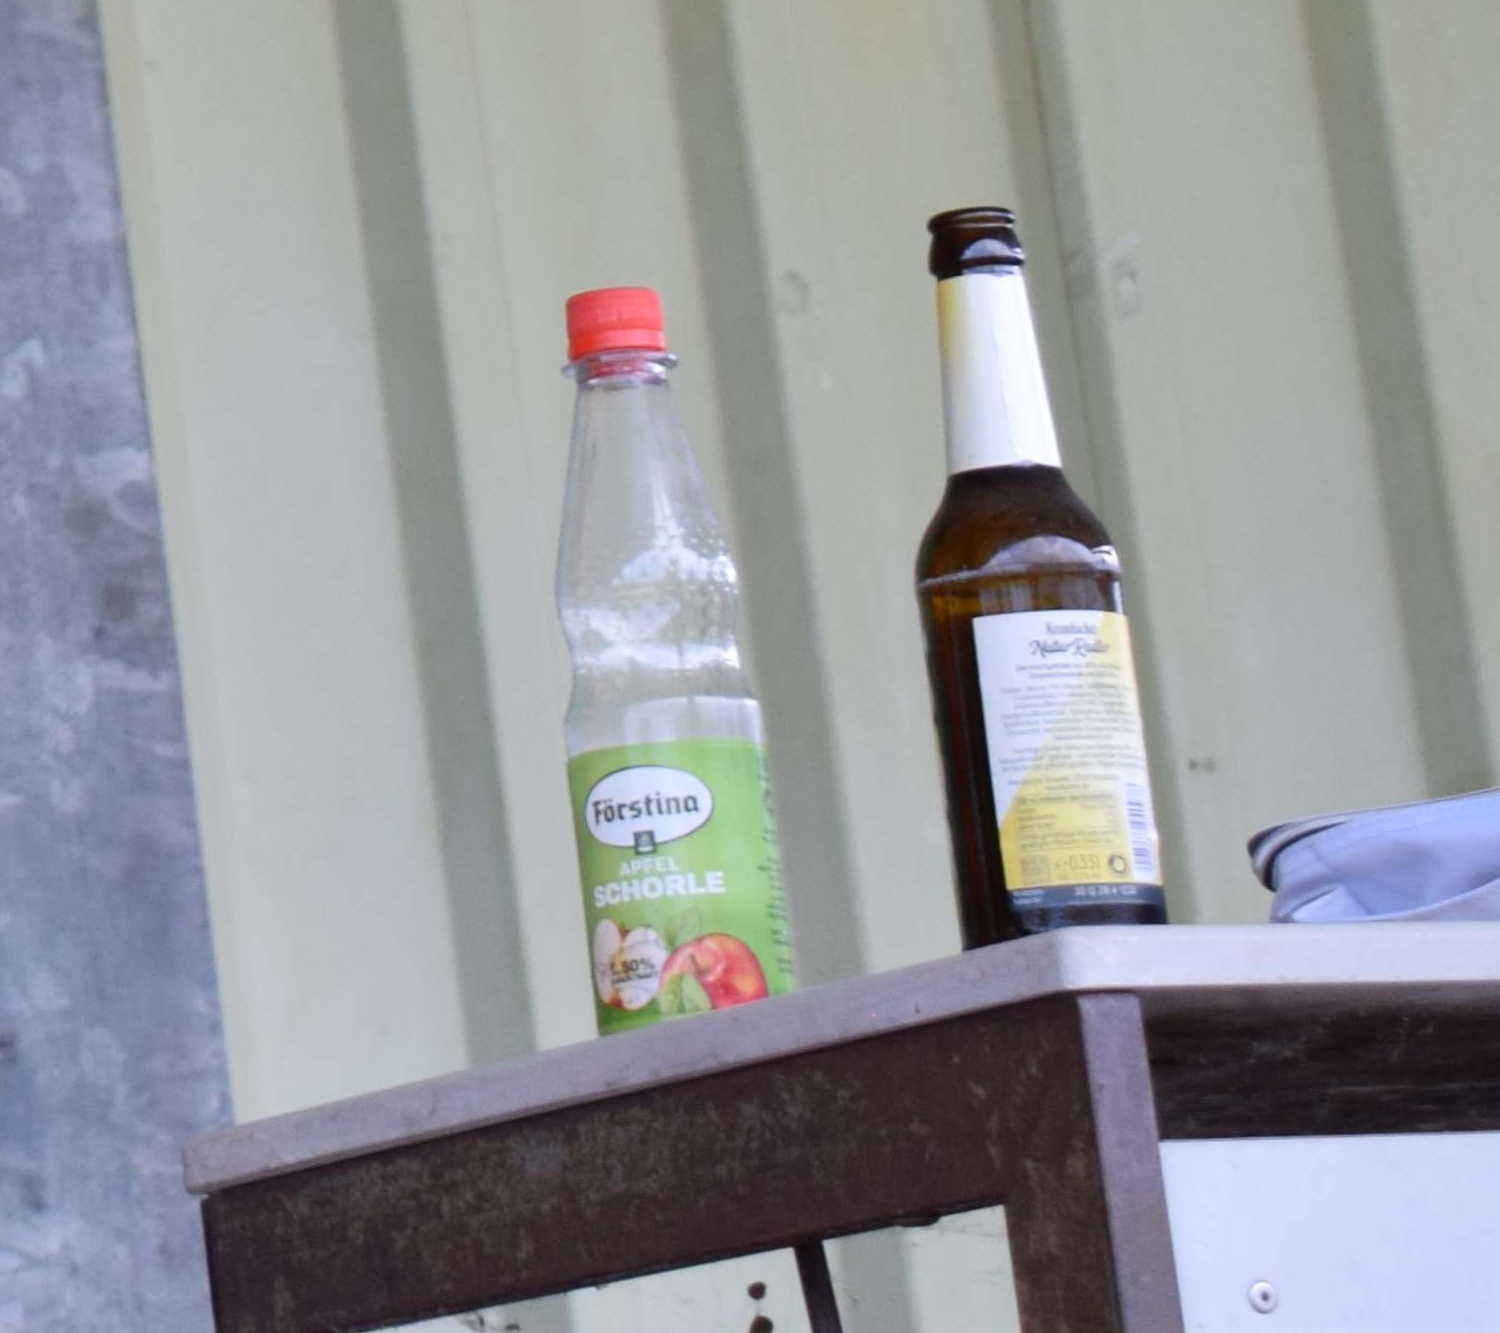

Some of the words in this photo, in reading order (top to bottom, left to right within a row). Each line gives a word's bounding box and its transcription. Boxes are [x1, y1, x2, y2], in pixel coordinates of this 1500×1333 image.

[592, 791, 701, 826] Förstina
[618, 856, 682, 878] APFEL
[593, 870, 727, 909] SCHORLE
